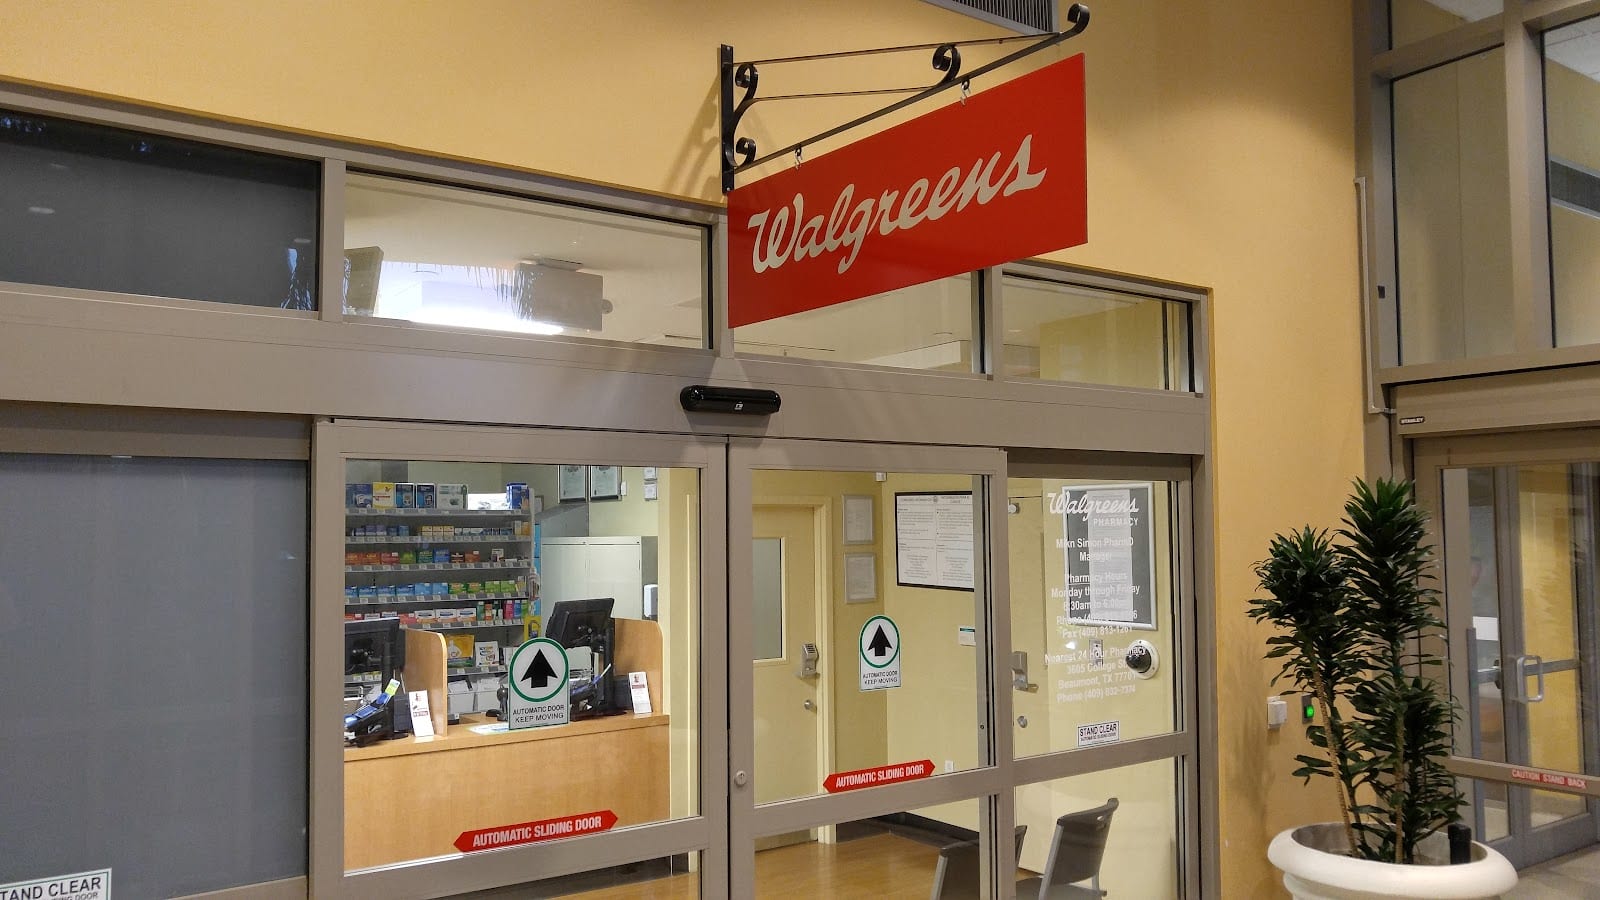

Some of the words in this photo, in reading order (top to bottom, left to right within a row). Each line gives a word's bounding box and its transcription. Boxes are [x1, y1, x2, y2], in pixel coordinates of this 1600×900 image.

[748, 134, 1047, 275] Walgreens
[1047, 491, 1139, 522] Walgreens
[1093, 517, 1139, 527] PHARMACY
[879, 676, 898, 684] MOVING
[513, 705, 547, 715] AUTOMATIC
[547, 704, 565, 712] DOOR
[515, 715, 534, 723] KEEP
[535, 712, 564, 721] MOVING
[1079, 726, 1099, 737] STAND
[1099, 723, 1117, 734] CLEAR
[835, 772, 876, 789] AUTOMATIC
[877, 767, 904, 781] SLIDING
[905, 764, 924, 777] DOOR
[1511, 768, 1541, 781] CAUTION
[1542, 773, 1566, 785] STAND
[1567, 777, 1587, 789] BACK
[472, 827, 532, 848] AUTOMATIC
[533, 820, 573, 838] SLIDING
[574, 815, 602, 832] DOOR
[0, 886, 43, 900] TAND
[48, 877, 101, 897] CLEAR
